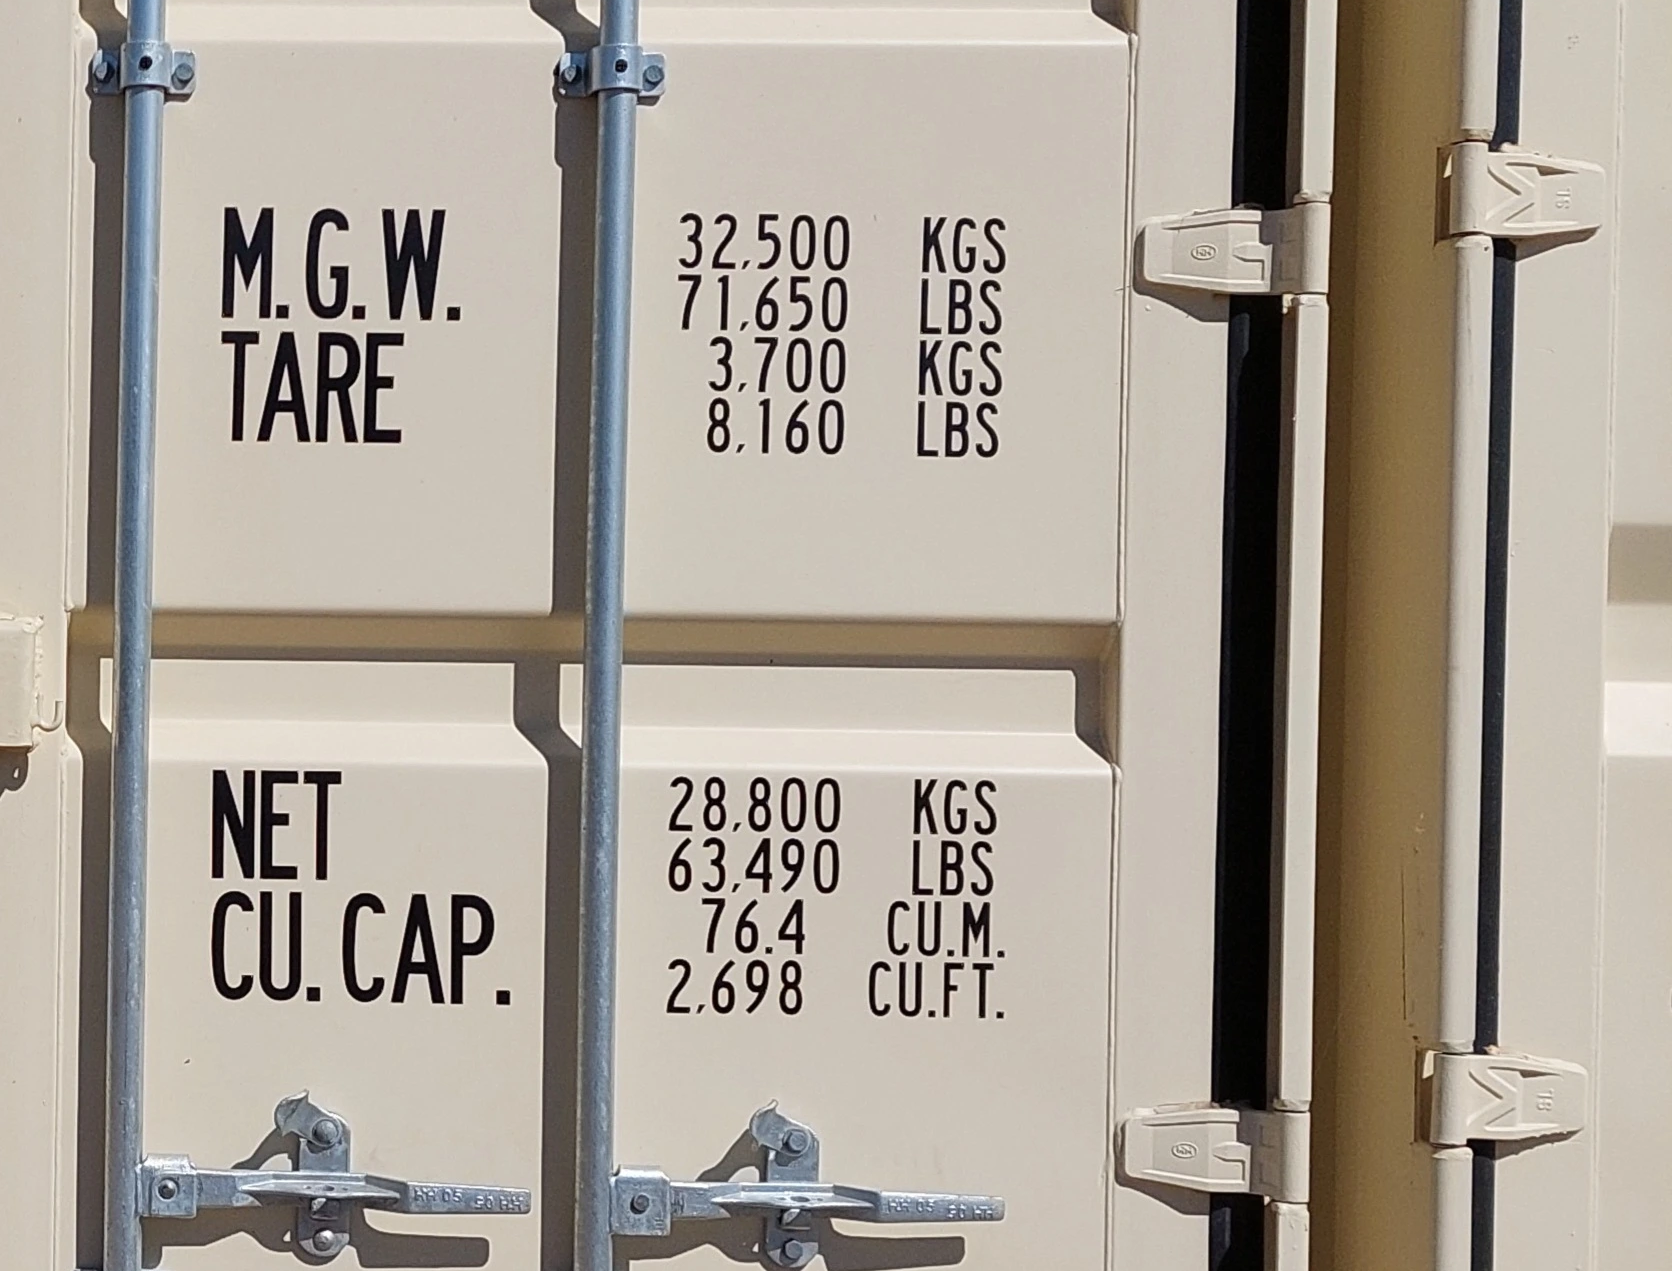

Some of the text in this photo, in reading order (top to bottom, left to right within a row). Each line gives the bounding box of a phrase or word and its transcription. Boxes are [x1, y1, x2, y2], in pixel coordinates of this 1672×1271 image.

[222, 208, 460, 320] M.G.W.
[679, 213, 1005, 273] 32,500 KGS
[678, 275, 1001, 335] 71,650 LBS
[222, 331, 404, 443] TARE
[710, 337, 1002, 396] 3,700 KGS
[707, 398, 998, 457] 8,160 LBS
[212, 770, 341, 880] NET
[669, 777, 996, 835] 28,800 KGS
[669, 838, 993, 896] 63,490 LBS
[702, 898, 1004, 957] 76.4 CU.M.
[667, 959, 1004, 1018] 2,698 CU.FT.
